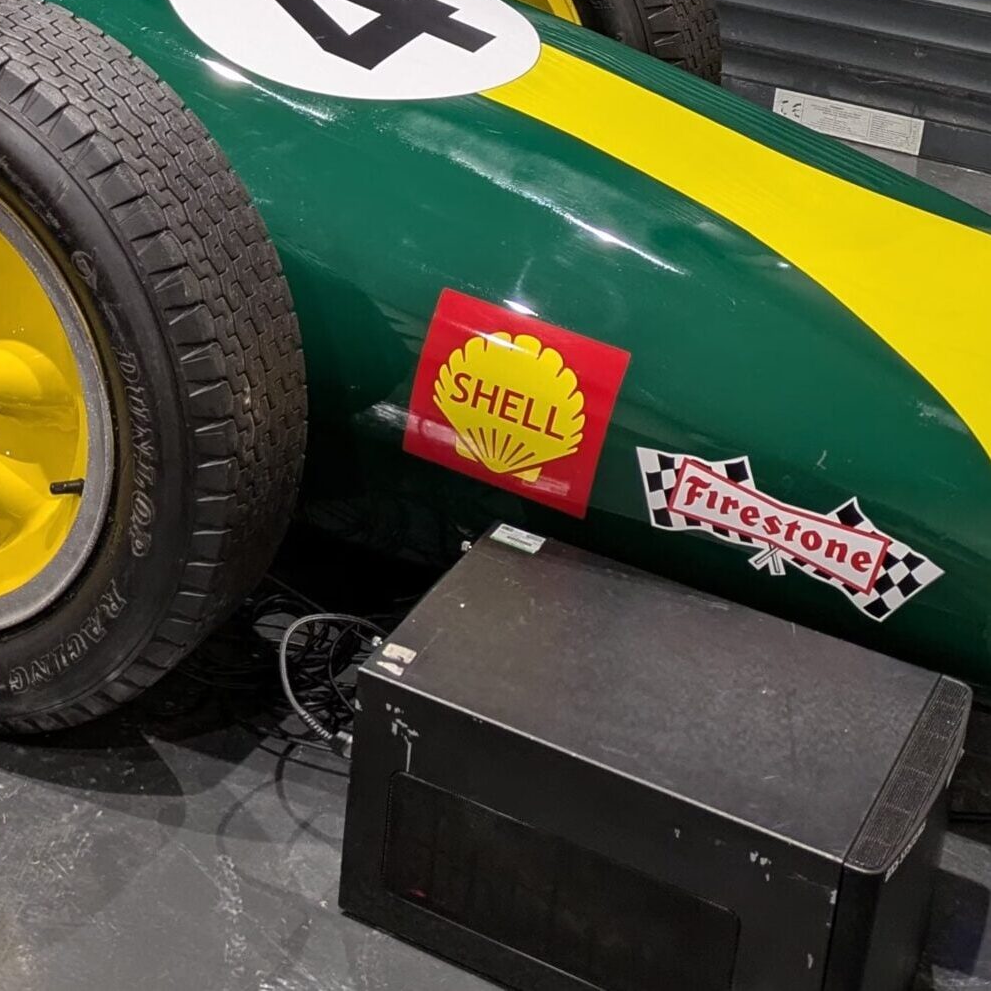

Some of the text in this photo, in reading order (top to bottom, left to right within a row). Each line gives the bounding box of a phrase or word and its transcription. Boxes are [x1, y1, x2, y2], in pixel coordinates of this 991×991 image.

[450, 372, 565, 442] SHELL
[682, 475, 874, 573] Firestone
[9, 578, 128, 695] RACING
